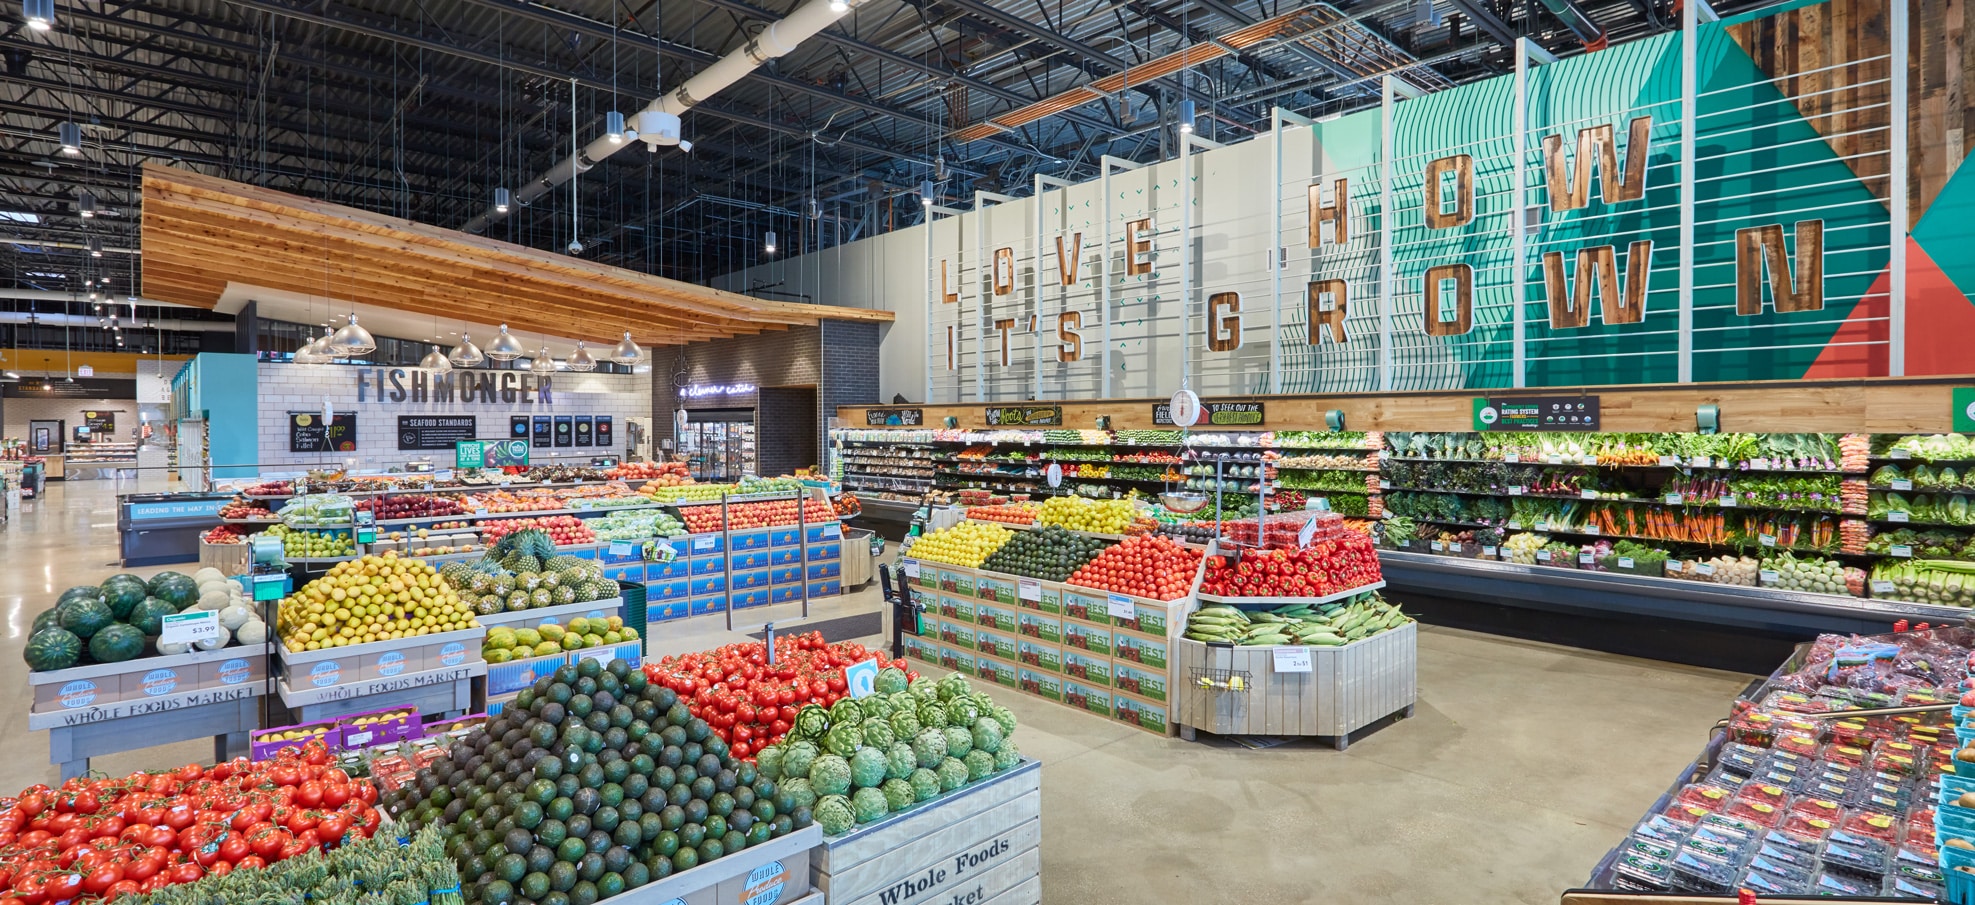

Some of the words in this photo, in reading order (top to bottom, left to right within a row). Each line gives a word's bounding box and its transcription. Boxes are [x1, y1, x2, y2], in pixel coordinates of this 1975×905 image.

[941, 218, 1155, 304] LOVE
[1308, 115, 1653, 249] HOW
[946, 310, 1085, 370] IT'S
[1206, 219, 1824, 352] GROWN
[357, 368, 552, 404] FISHMONGER
[726, 383, 755, 394] catch
[1212, 404, 1219, 412] TO
[1235, 404, 1247, 412] OUT
[1248, 404, 1259, 412] THE
[409, 418, 437, 427] SEAFOOD
[438, 418, 473, 427] STANDARDS
[956, 577, 973, 588] BEST
[995, 586, 1014, 597] BEST
[956, 603, 973, 613] BEST
[1087, 602, 1108, 615] BEST
[995, 612, 1014, 624] BEST
[1139, 613, 1165, 628] BEST
[192, 626, 215, 634] $3.99
[1038, 621, 1059, 634] BEST
[956, 630, 973, 641] BEST
[1086, 632, 1109, 646] BEST
[995, 640, 1014, 651] BEST
[1139, 644, 1165, 660] BEST
[956, 656, 973, 667] BEST
[1038, 650, 1059, 663] BEST
[995, 667, 1014, 679] BEST
[1086, 662, 1109, 676] BEST
[149, 672, 173, 680] WHOLE
[66, 683, 92, 692] WHOLE
[317, 686, 364, 702] WHOLE
[369, 680, 410, 694] FOODS
[415, 668, 471, 685] MARKET
[1038, 679, 1059, 692] BEST
[1139, 676, 1165, 691] BEST
[1086, 693, 1109, 706] BEST
[64, 707, 125, 726] WHOLE
[130, 699, 181, 716] FOODS
[187, 687, 254, 707] MARKET
[1139, 708, 1165, 724] BEST
[752, 864, 779, 882] WHOLE
[879, 869, 946, 905] Whole
[955, 839, 1009, 875] Foods
[747, 877, 782, 899] Produce
[949, 884, 984, 905] ket
